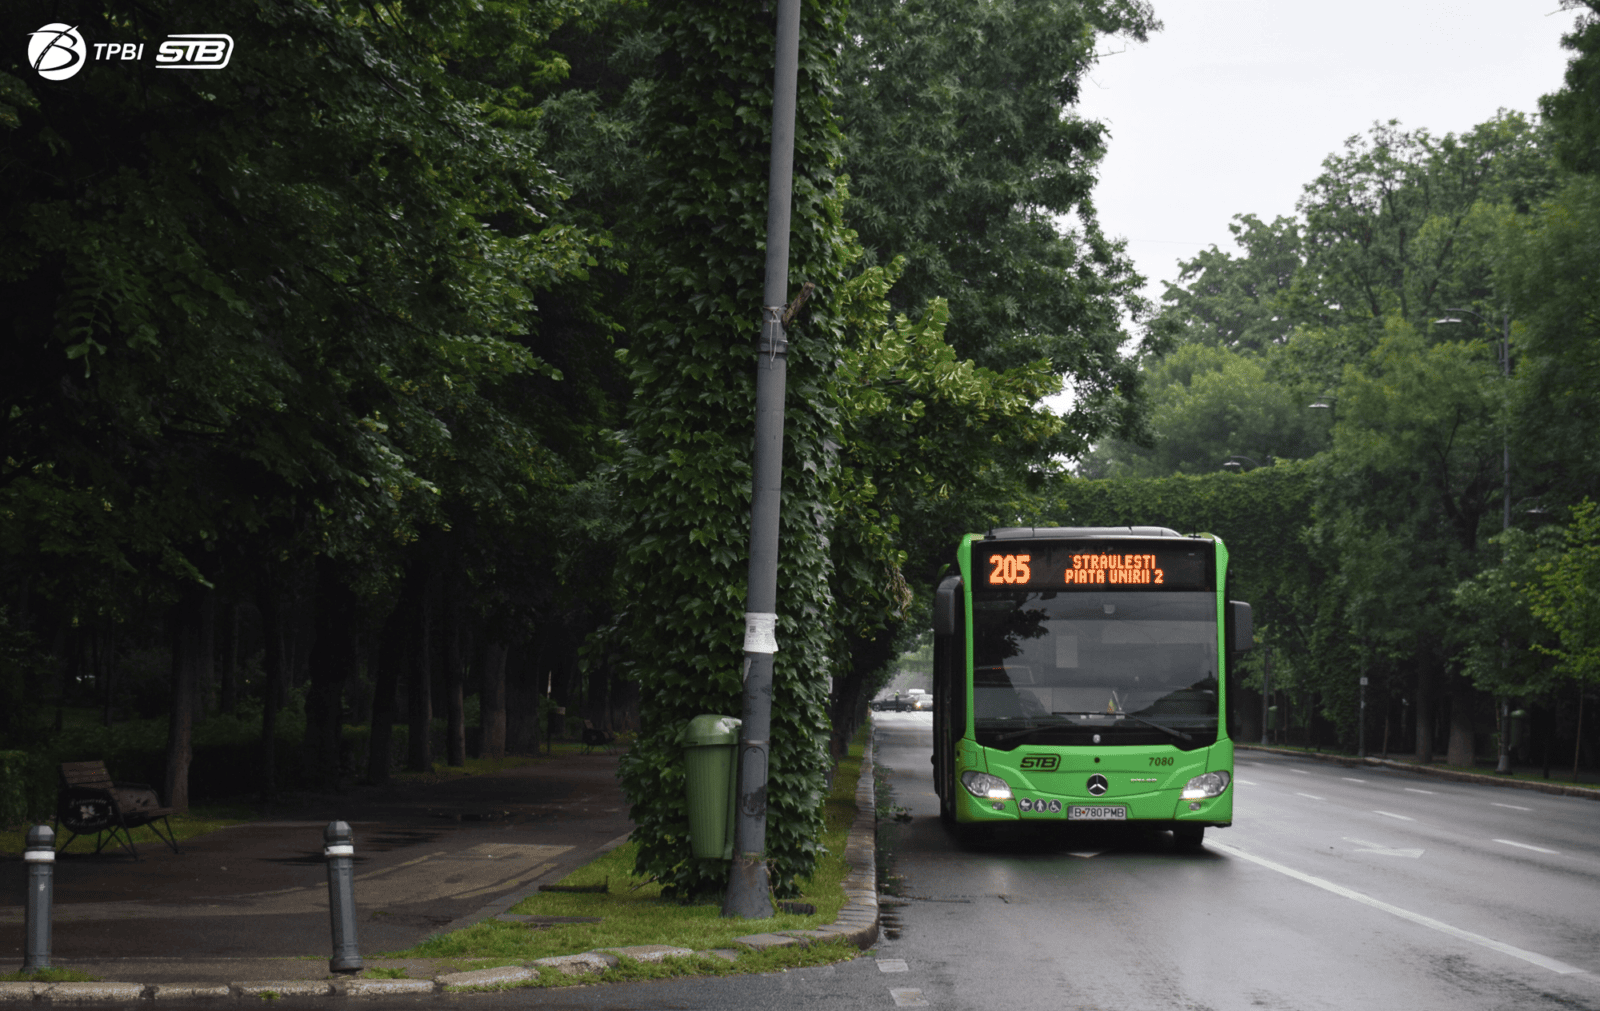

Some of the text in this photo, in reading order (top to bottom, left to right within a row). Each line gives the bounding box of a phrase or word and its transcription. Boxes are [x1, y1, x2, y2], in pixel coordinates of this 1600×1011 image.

[989, 553, 1031, 585] 205
[1064, 568, 1165, 584] PIATA UNIRII 2
[1020, 756, 1057, 769] STB
[1149, 756, 1175, 767] 7080
